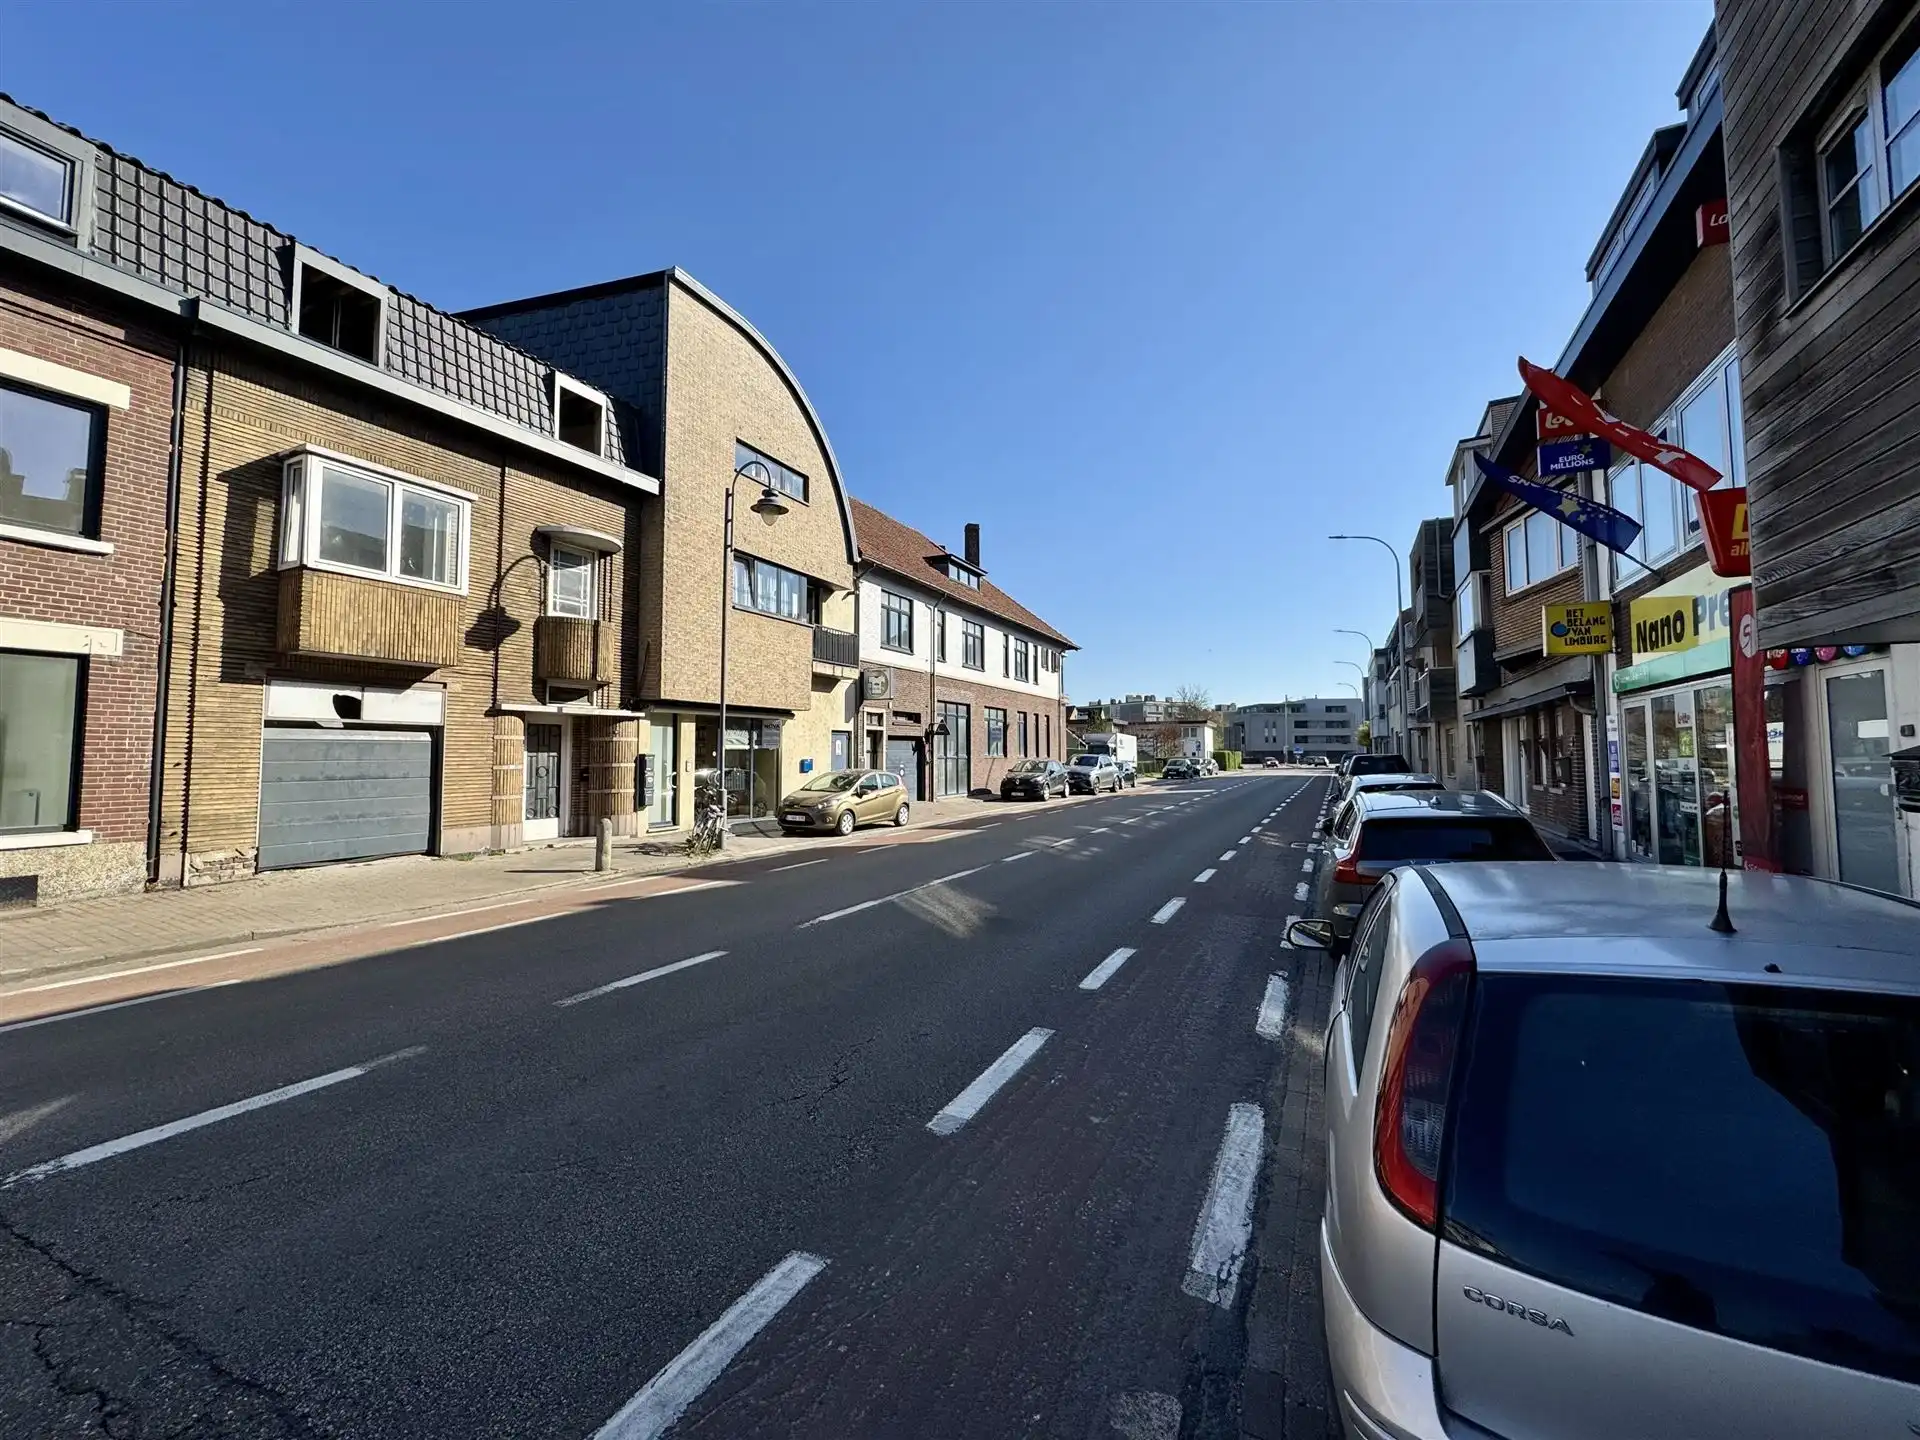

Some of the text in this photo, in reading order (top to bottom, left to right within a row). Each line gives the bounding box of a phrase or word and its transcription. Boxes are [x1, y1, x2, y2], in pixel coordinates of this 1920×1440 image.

[1550, 457, 1595, 471] MILLIONS
[1558, 453, 1585, 463] EURO
[1566, 608, 1584, 618] HET
[1566, 616, 1606, 627] BELANG
[1571, 626, 1592, 636] VAN
[1635, 609, 1685, 653] Nano
[1564, 634, 1608, 647] LIMBURG
[1463, 1284, 1575, 1337] CORSA
